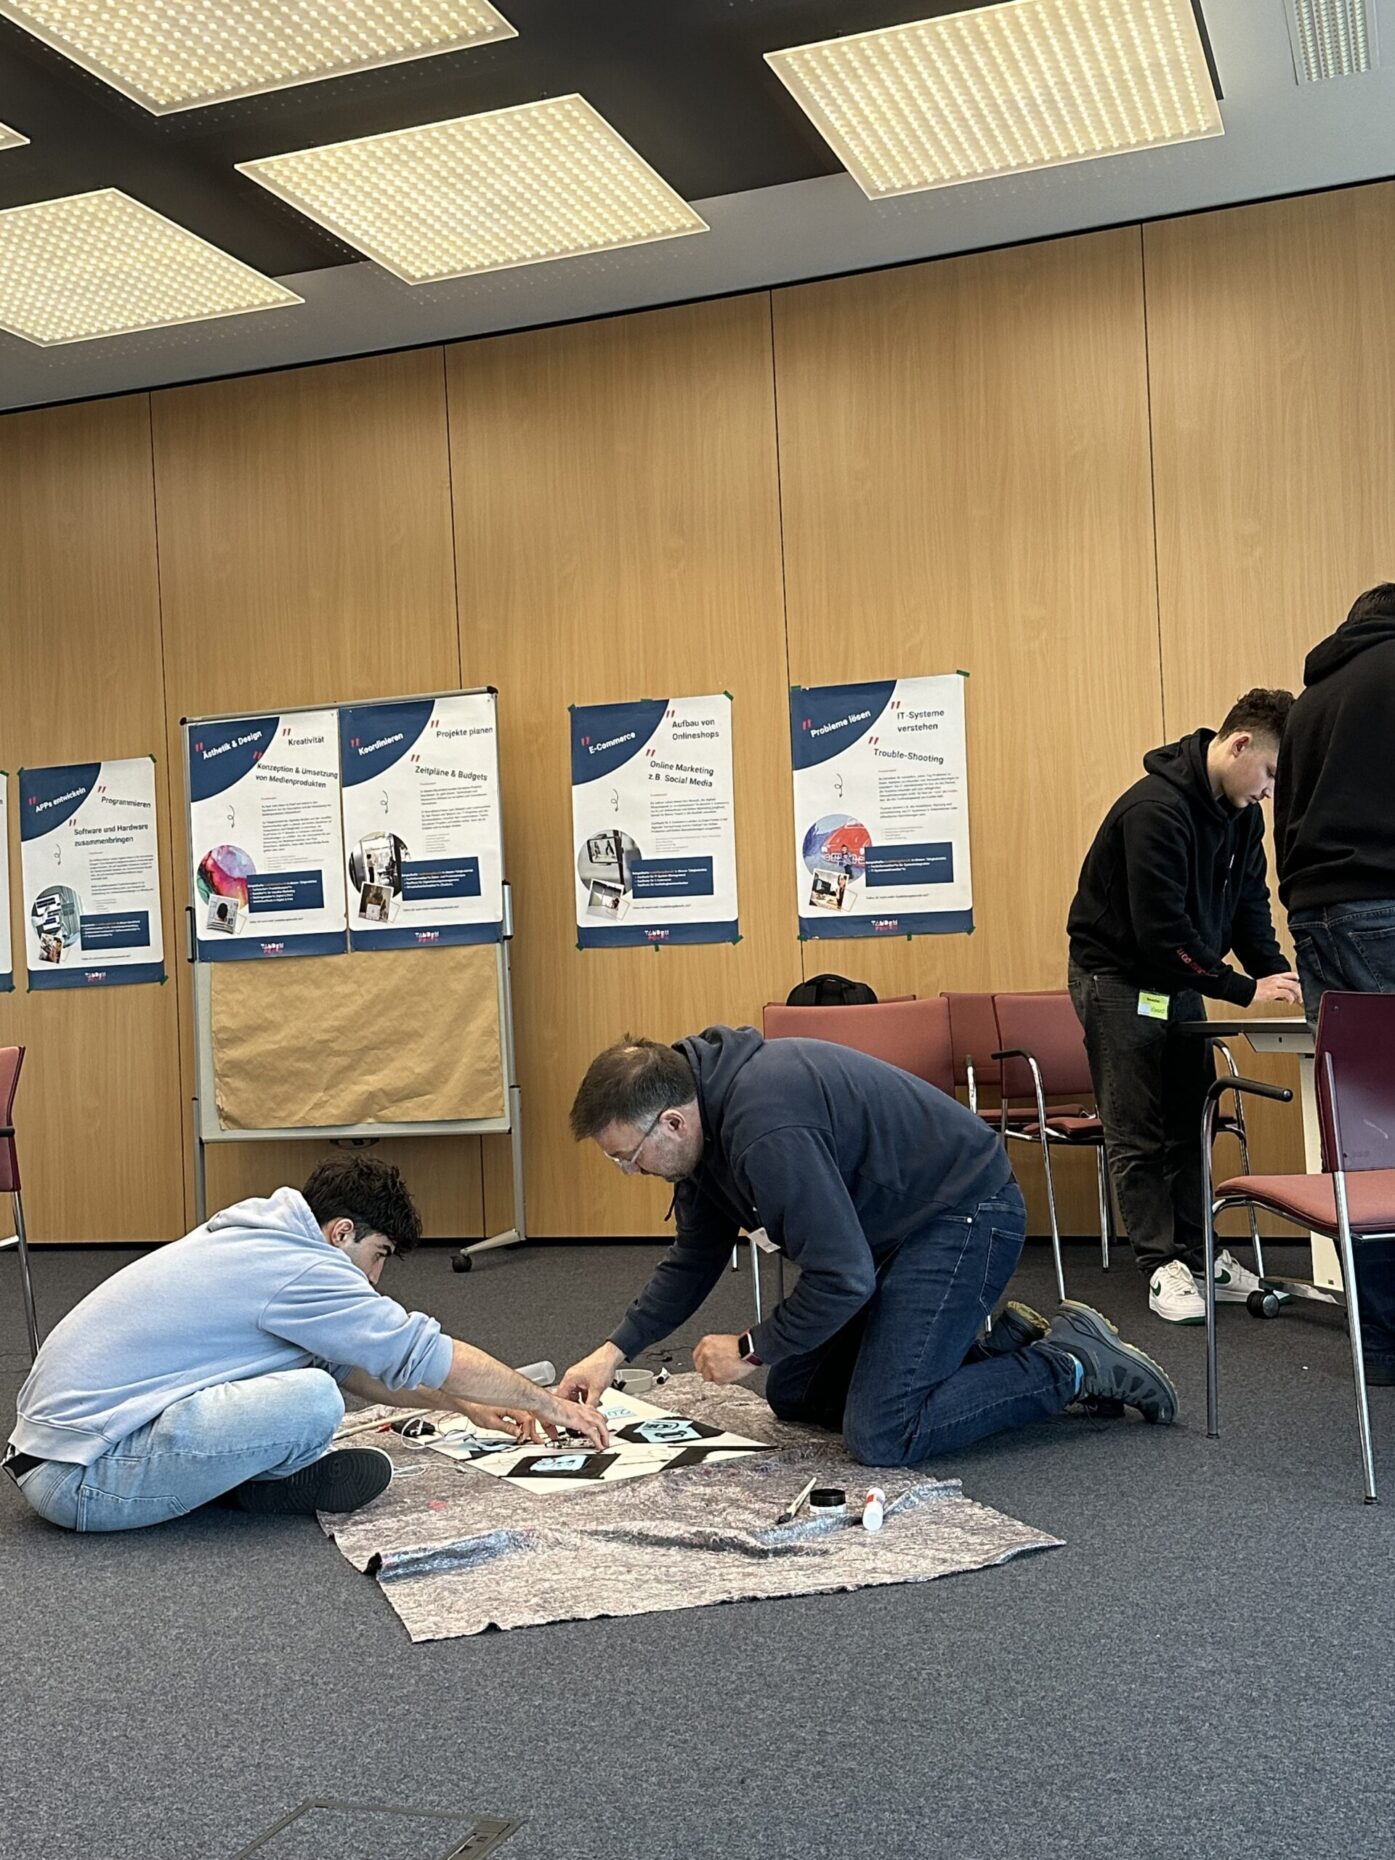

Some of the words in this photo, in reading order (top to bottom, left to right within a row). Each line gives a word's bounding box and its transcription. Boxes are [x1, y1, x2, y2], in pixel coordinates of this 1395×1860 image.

[897, 710, 945, 720] IT-Systeme
[672, 719, 699, 729] Aufbau
[810, 719, 848, 738] Probleme
[849, 710, 871, 724] lösen
[897, 723, 938, 733] verstehen
[436, 728, 467, 738] Projekte
[469, 727, 493, 736] planen
[672, 731, 719, 741] Onlineshops
[202, 741, 231, 760] Ästhetik
[231, 739, 238, 748] &
[238, 731, 262, 746] Design
[288, 736, 324, 746] Kreativität
[358, 733, 404, 755] Koordinieren
[588, 732, 636, 754] E-Commerce
[874, 748, 944, 765] Trouble-Shooting
[257, 762, 293, 773] Konzeption
[301, 768, 338, 779] Umsetzung
[415, 765, 449, 777] Zeitpläne
[458, 770, 488, 781] Budgets
[650, 760, 674, 771] Online
[675, 764, 714, 776] Marketing
[269, 775, 327, 788] Medienprodukten
[665, 775, 688, 784] Social
[689, 778, 713, 787] Media
[35, 801, 53, 813] APPs
[53, 787, 86, 806] entwickeln
[101, 796, 151, 808] Programmieren
[74, 827, 102, 835] Software
[117, 823, 148, 832] Hardware
[74, 836, 133, 847] zusammenbringen
